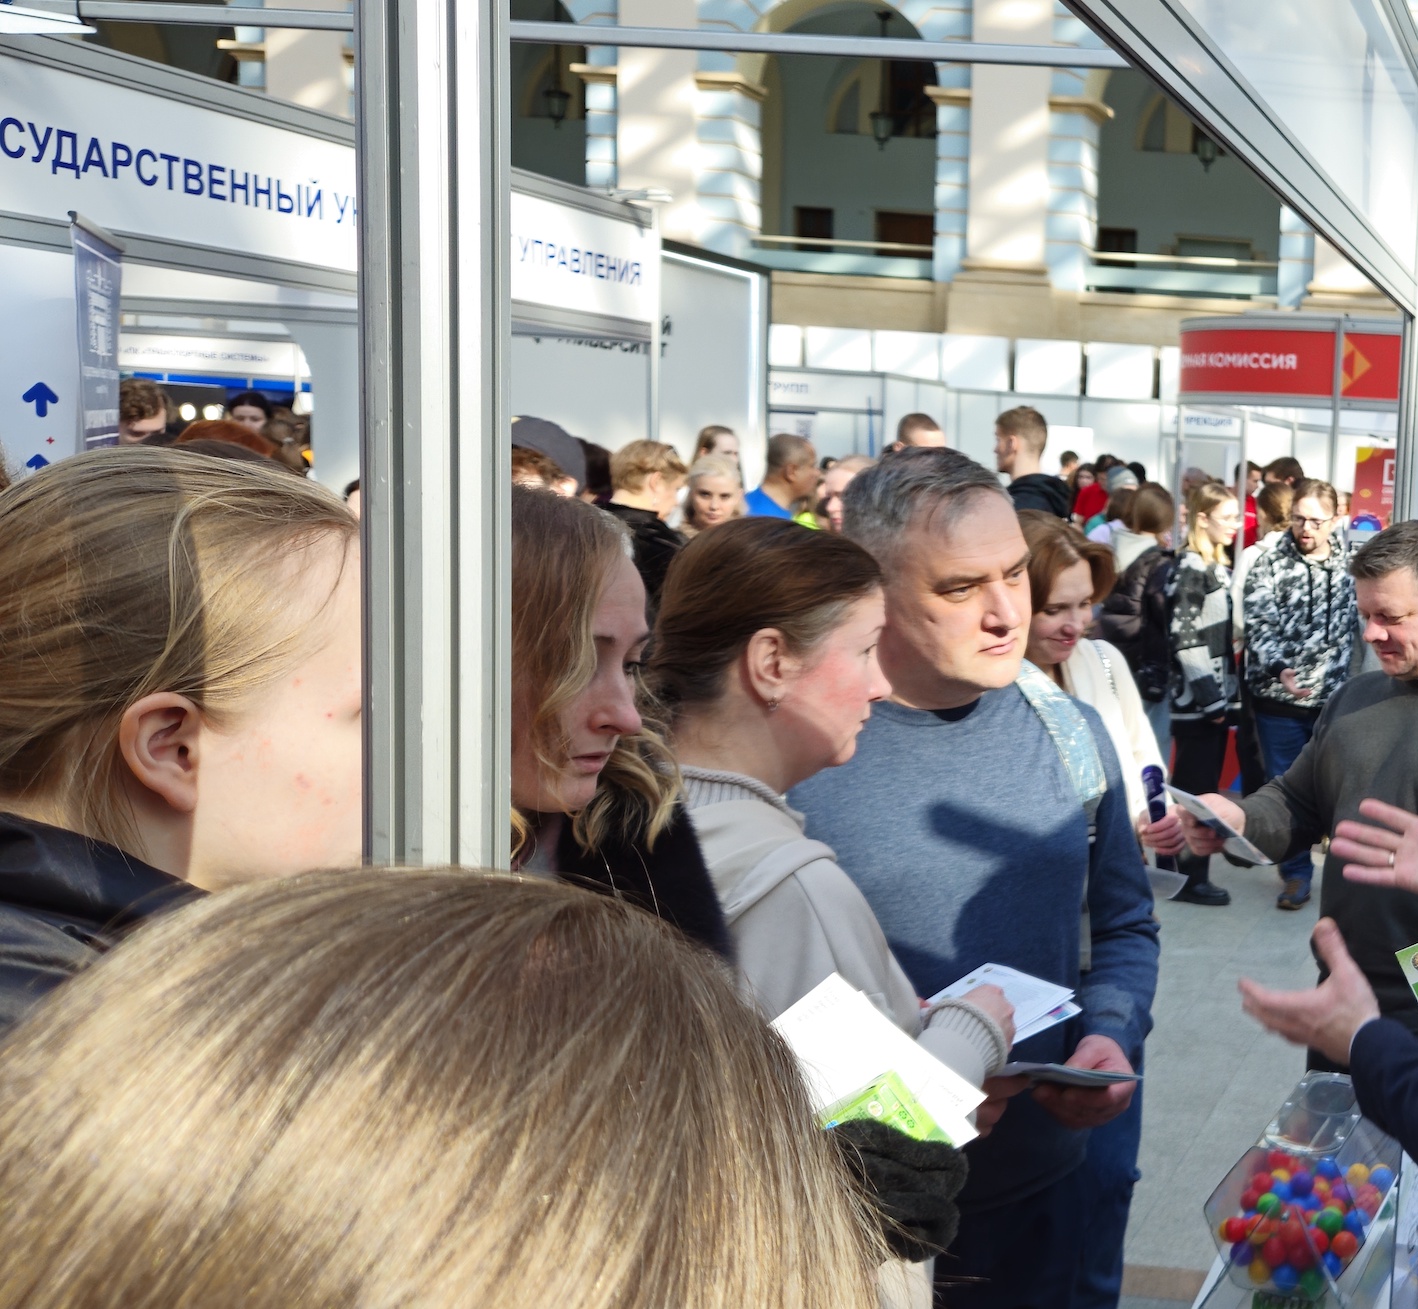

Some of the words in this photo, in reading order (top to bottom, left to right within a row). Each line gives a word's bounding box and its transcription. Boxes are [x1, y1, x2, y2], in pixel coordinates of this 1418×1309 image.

[0, 117, 323, 220] СУДАРСТВЕННЫЙ
[518, 236, 642, 286] УПРАВЛЕНИЯ
[1209, 352, 1297, 370] КОМИССИЯ
